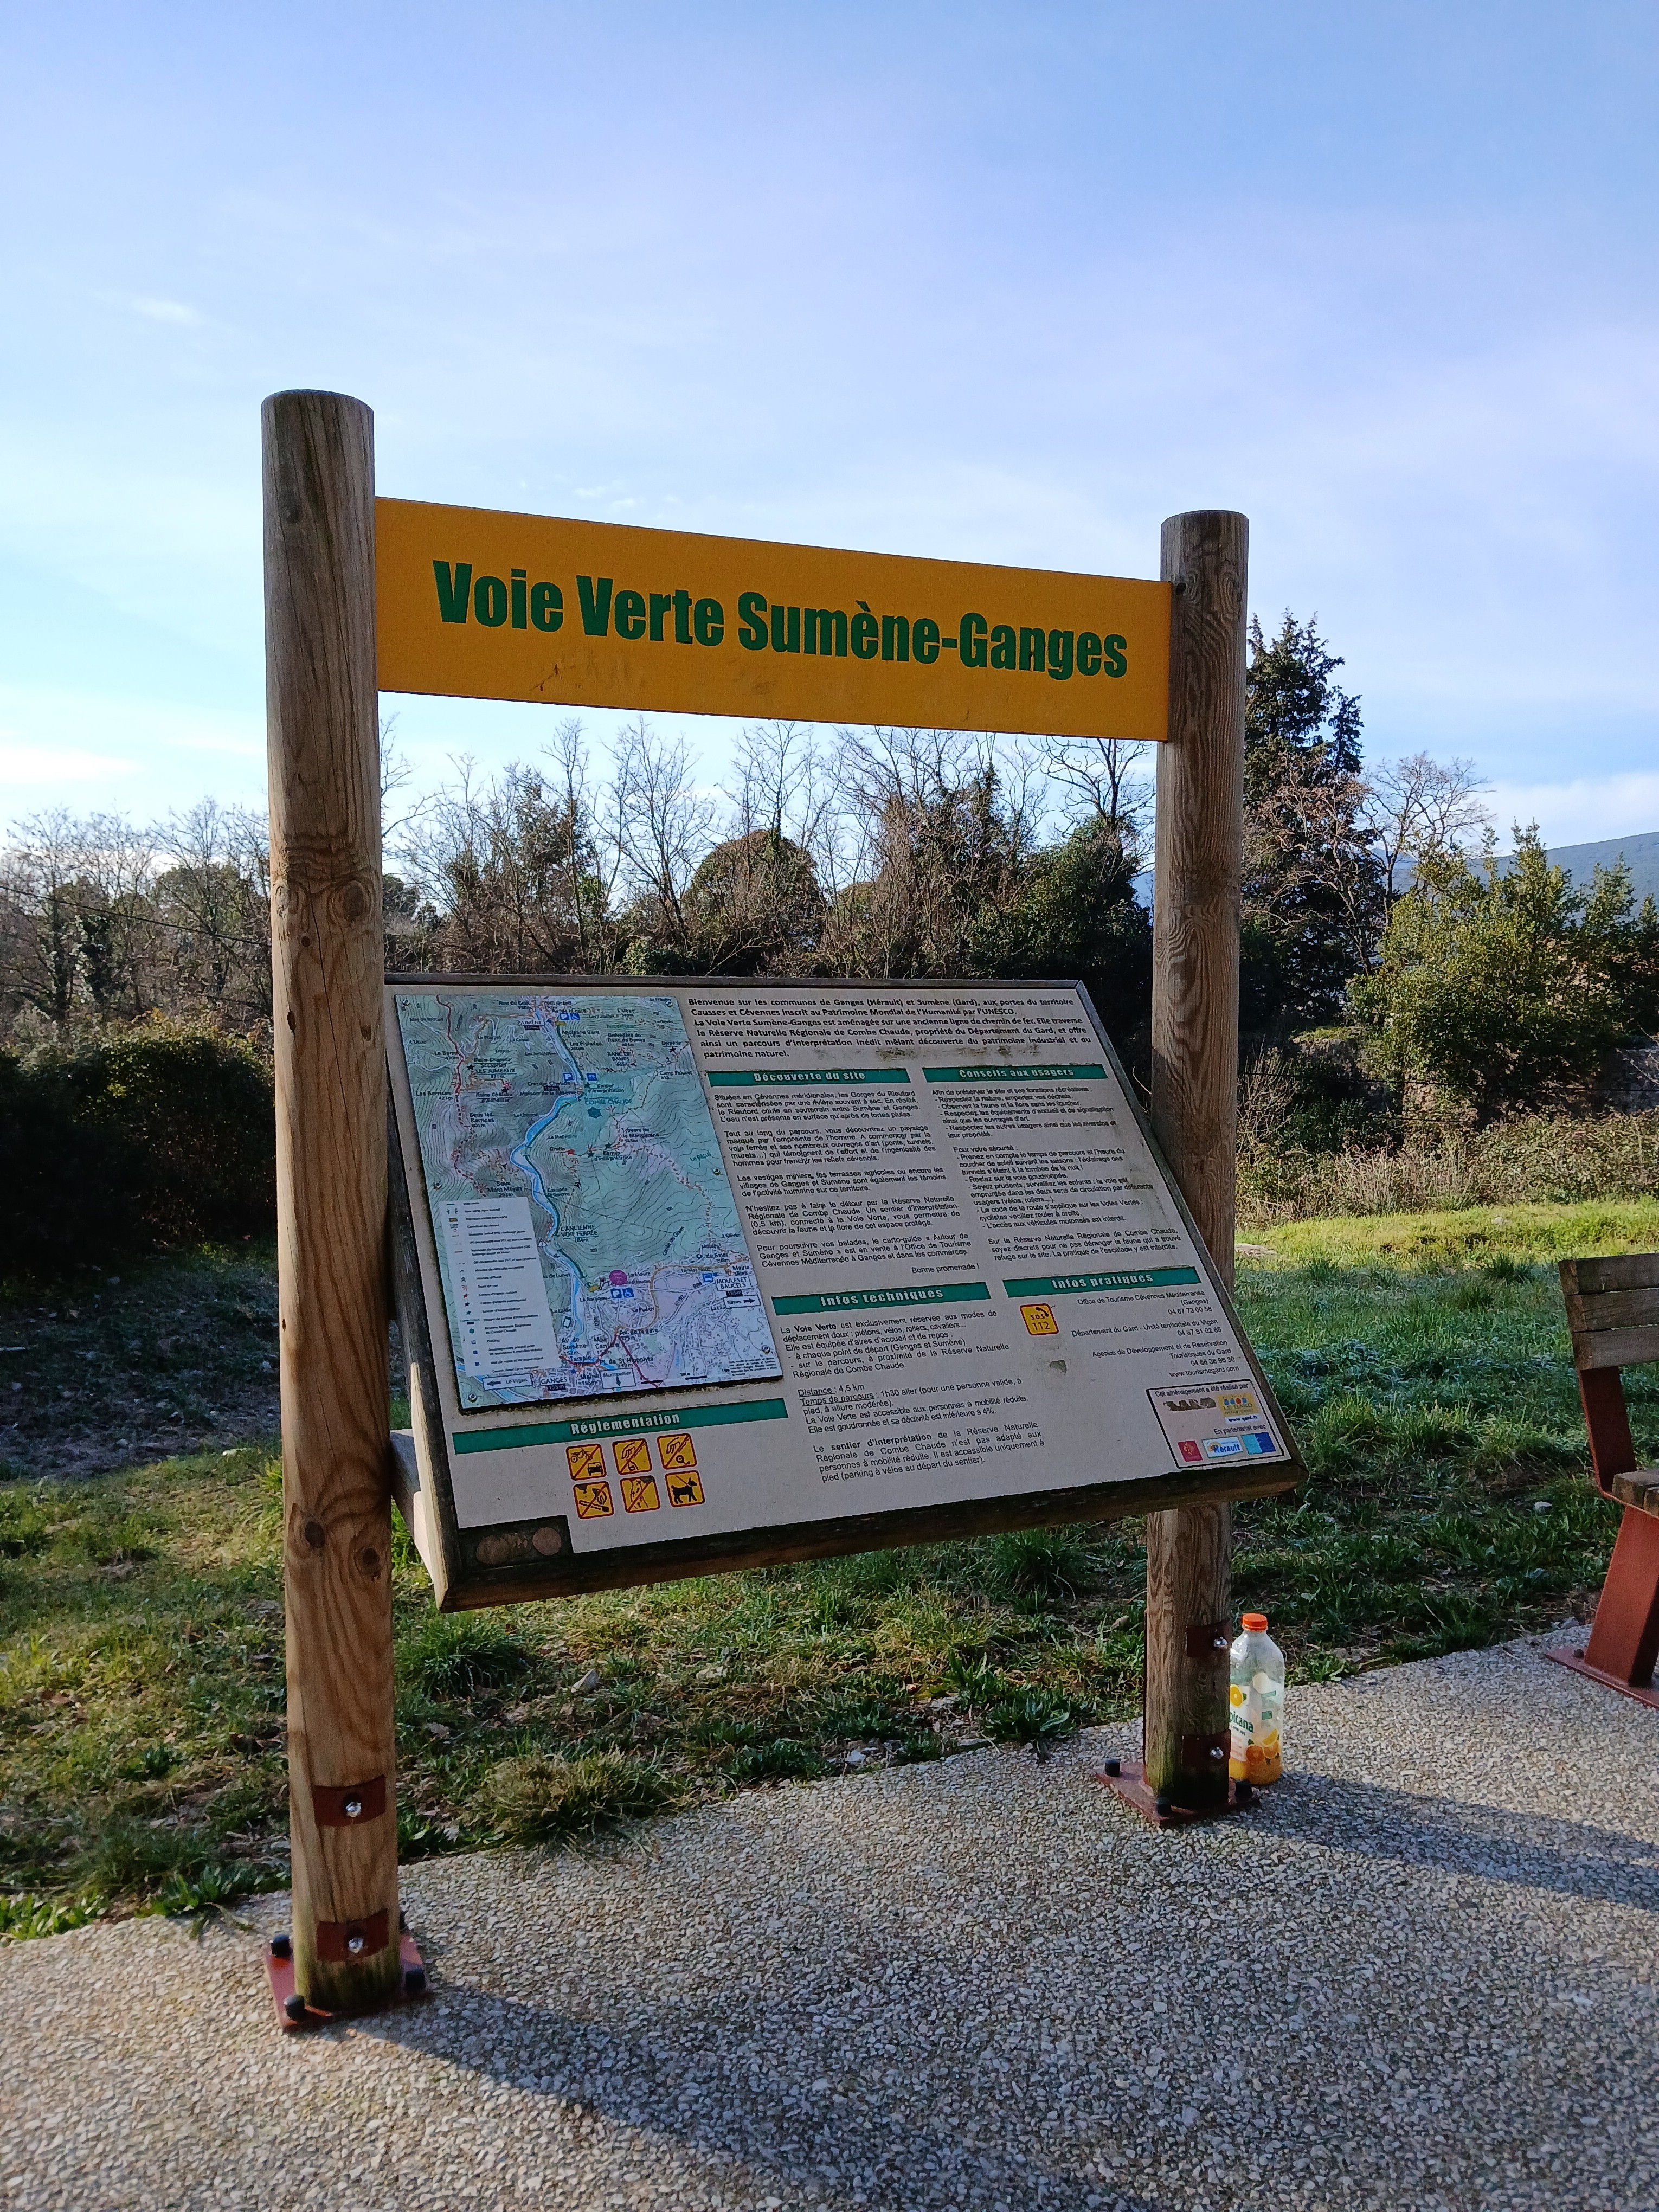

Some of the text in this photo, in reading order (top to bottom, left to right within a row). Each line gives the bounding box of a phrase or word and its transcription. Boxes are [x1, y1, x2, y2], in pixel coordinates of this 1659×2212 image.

[433, 561, 1127, 680] Voie Verte Sumène-Ganges
[819, 998, 831, 1006] de
[833, 998, 864, 1007] Ganges
[866, 998, 904, 1008] (Hérault)
[916, 998, 950, 1006] Sumène
[951, 998, 980, 1007] (Gard),
[1001, 999, 1025, 1007] portes
[738, 1008, 781, 1016] Cévennes
[781, 1008, 808, 1016] inscrit
[916, 1007, 961, 1015] l'Humanité
[976, 1006, 1017, 1015] l'UNESCO.
[704, 1018, 726, 1026] Voie
[751, 1018, 822, 1028] Sumène-Ganges
[836, 1018, 880, 1027] aménagée
[948, 1017, 970, 1026] ligne
[969, 1017, 981, 1025] de
[696, 1028, 706, 1037] la
[708, 1028, 744, 1037] Réserve
[745, 1028, 787, 1037] Naturelle
[788, 1028, 832, 1037] Régionale
[878, 1027, 913, 1036] Chaude,
[914, 1027, 953, 1037] propriété
[967, 1025, 1021, 1036] Département
[1033, 1026, 1057, 1034] Gard,
[1068, 1026, 1087, 1034] offre
[784, 1038, 853, 1047] d'interprétation
[855, 1038, 882, 1046] inédit
[981, 1037, 1026, 1046] patrimoine
[1029, 1036, 1066, 1046] industriel
[703, 1049, 790, 1059] patrimoine naturel.
[753, 1071, 865, 1081] Découverte du site
[959, 1069, 1007, 1077] Conseils
[1031, 1069, 1074, 1077] usagers
[731, 1159, 764, 1167] hommes
[765, 1159, 782, 1167] pour
[783, 1157, 811, 1165] franchir
[935, 1262, 976, 1274] promenade
[1051, 1274, 1153, 1289] Infos pratiques
[820, 1289, 943, 1306] Infos techniques
[779, 1326, 791, 1334] La
[793, 1324, 812, 1333] Voie
[814, 1322, 837, 1331] Verte
[854, 1317, 908, 1328] exclusivement
[909, 1315, 941, 1323] réservée
[960, 1310, 985, 1319] modes
[1032, 1321, 1051, 1330] 112
[782, 1331, 831, 1343] déplacement
[830, 1330, 850, 1339] doux
[854, 1328, 883, 1338] piétons,
[883, 1326, 905, 1334] vélos,
[929, 1321, 967, 1330] cavaliers...
[792, 1361, 904, 1379] Régionale de Combe Chaude
[798, 1385, 832, 1398] Distance
[838, 1384, 852, 1393] 4,5
[852, 1383, 865, 1391] km
[570, 1413, 680, 1435] Réglementation
[812, 1420, 1038, 1453] Le sentier d'interprétation de la Réserve Naturelle
[821, 1472, 839, 1484] pied
[840, 1469, 874, 1481] (parking
[874, 1467, 881, 1476] à
[881, 1465, 903, 1475] vélos
[916, 1460, 942, 1471] départ
[942, 1459, 953, 1467] du
[954, 1455, 986, 1466] sentier).
